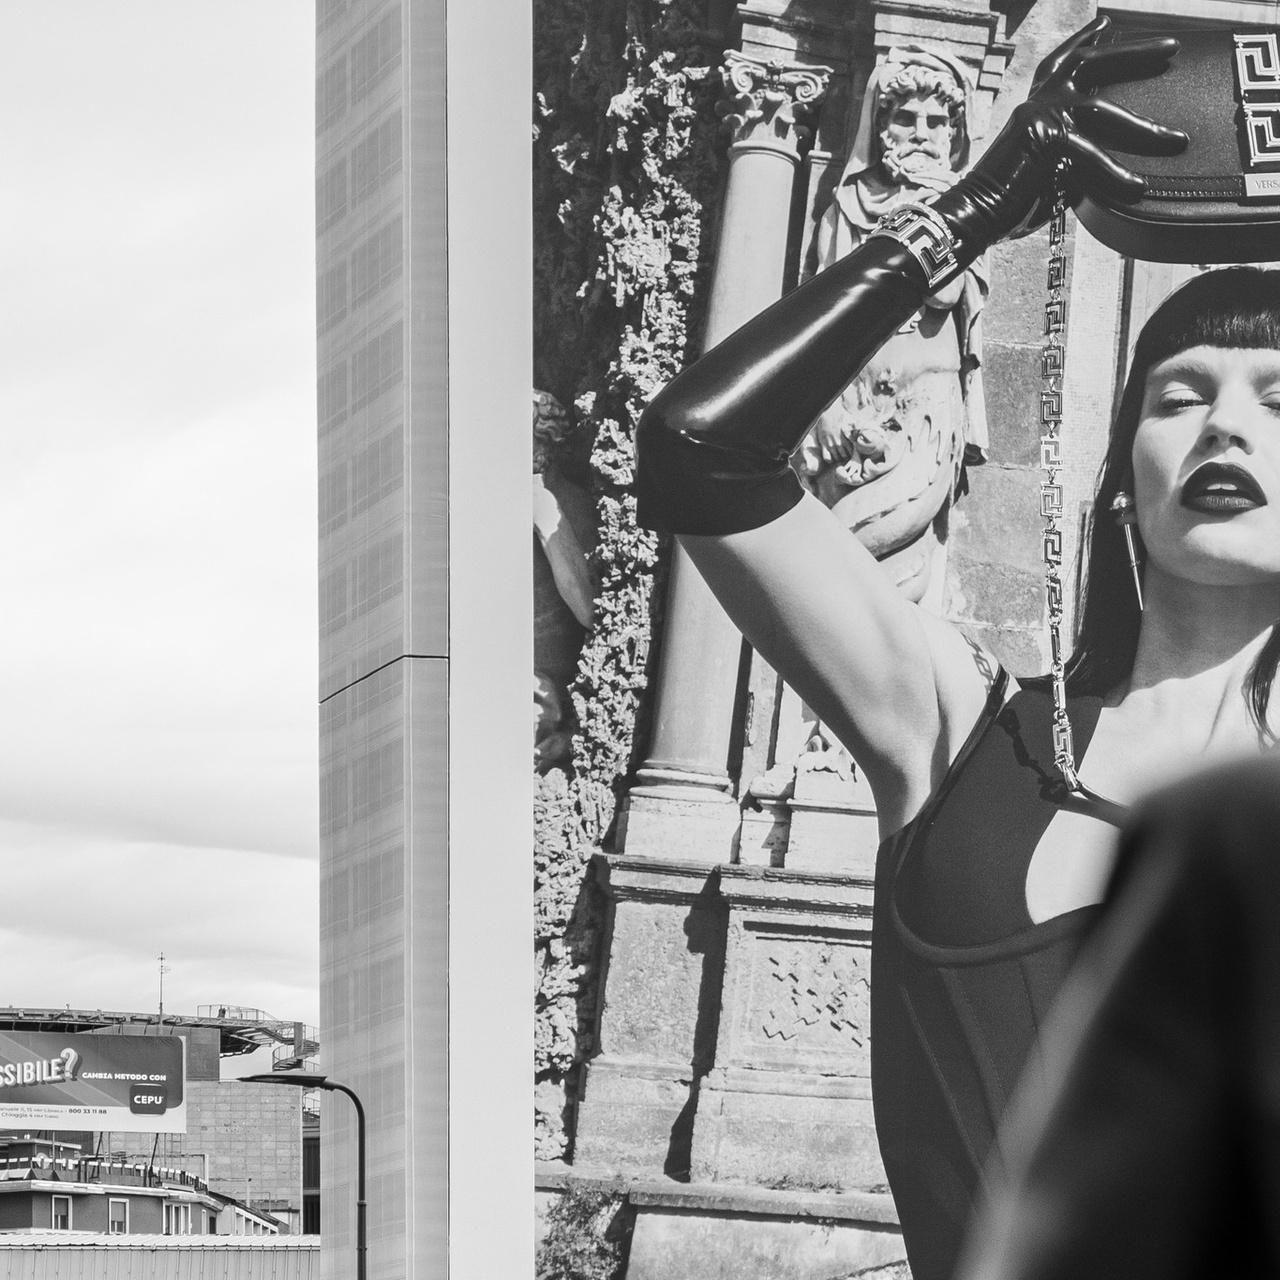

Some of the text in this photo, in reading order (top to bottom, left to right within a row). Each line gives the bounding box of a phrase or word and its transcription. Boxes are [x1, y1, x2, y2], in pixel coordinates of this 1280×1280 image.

[82, 1072, 113, 1080] CAMBIA
[114, 1073, 148, 1081] METODO
[133, 1095, 164, 1105] CEPU
